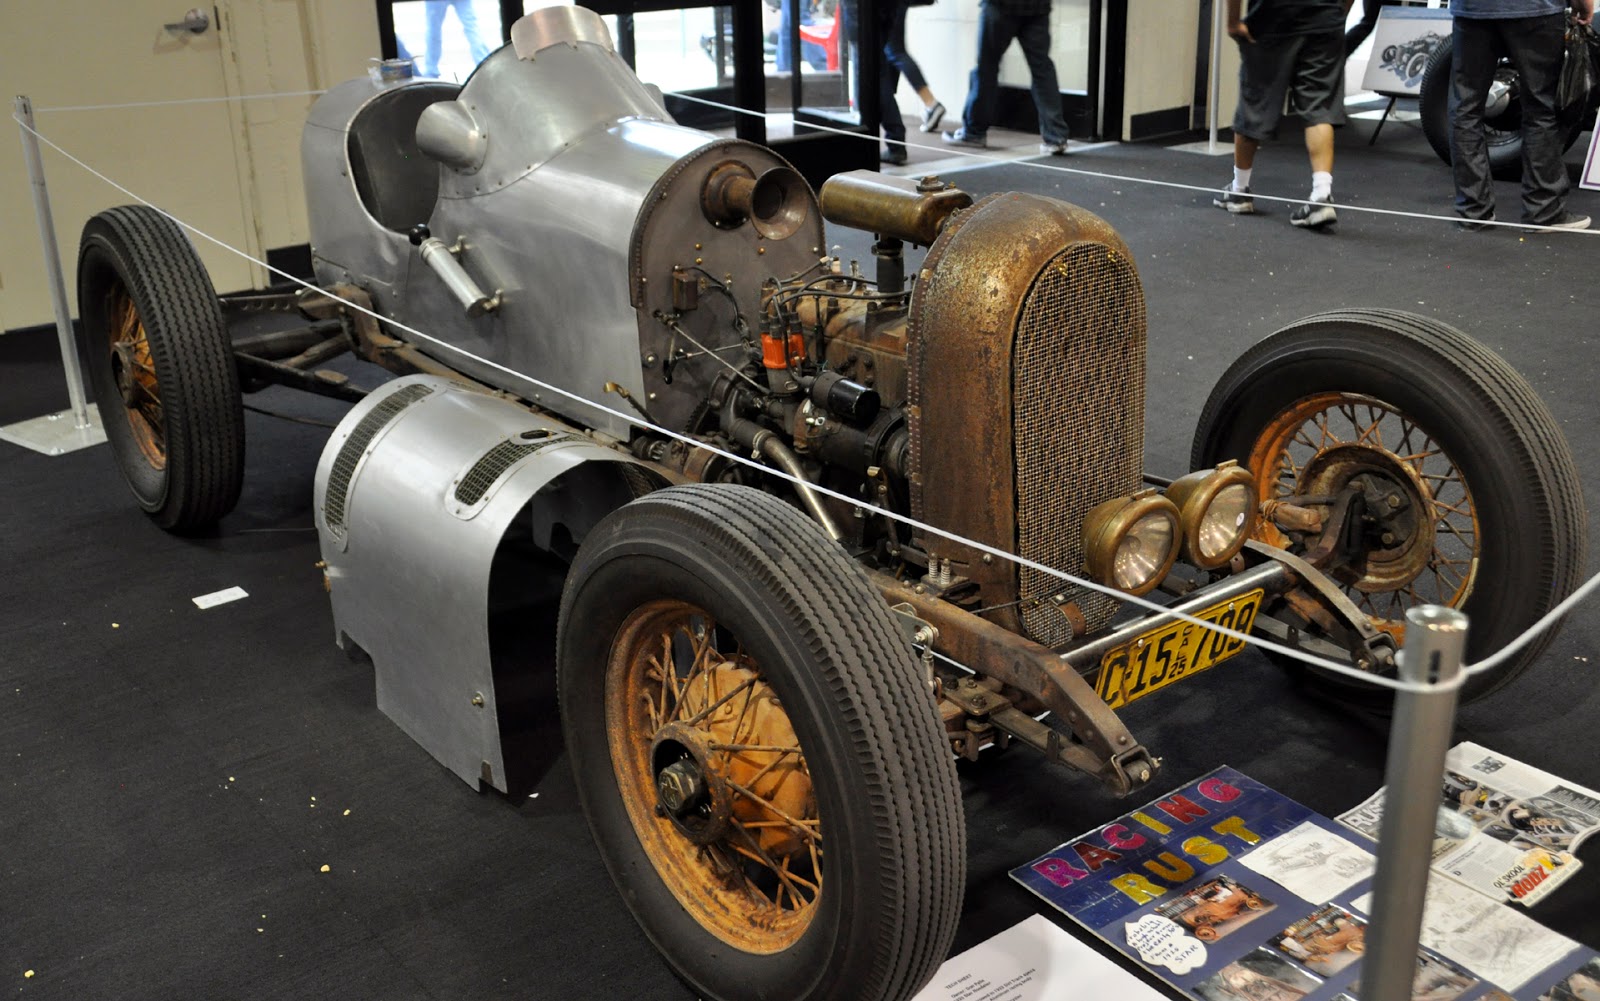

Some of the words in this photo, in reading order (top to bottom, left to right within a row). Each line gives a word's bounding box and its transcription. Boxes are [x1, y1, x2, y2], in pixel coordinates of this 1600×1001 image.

[1191, 602, 1255, 668] 709
[1168, 657, 1187, 679] 25
[1031, 777, 1243, 888] RACING
[1109, 816, 1261, 905] RUST
[1502, 864, 1526, 883] SKOOL
[1510, 865, 1550, 898] RODZ
[1175, 945, 1199, 963] STAR
